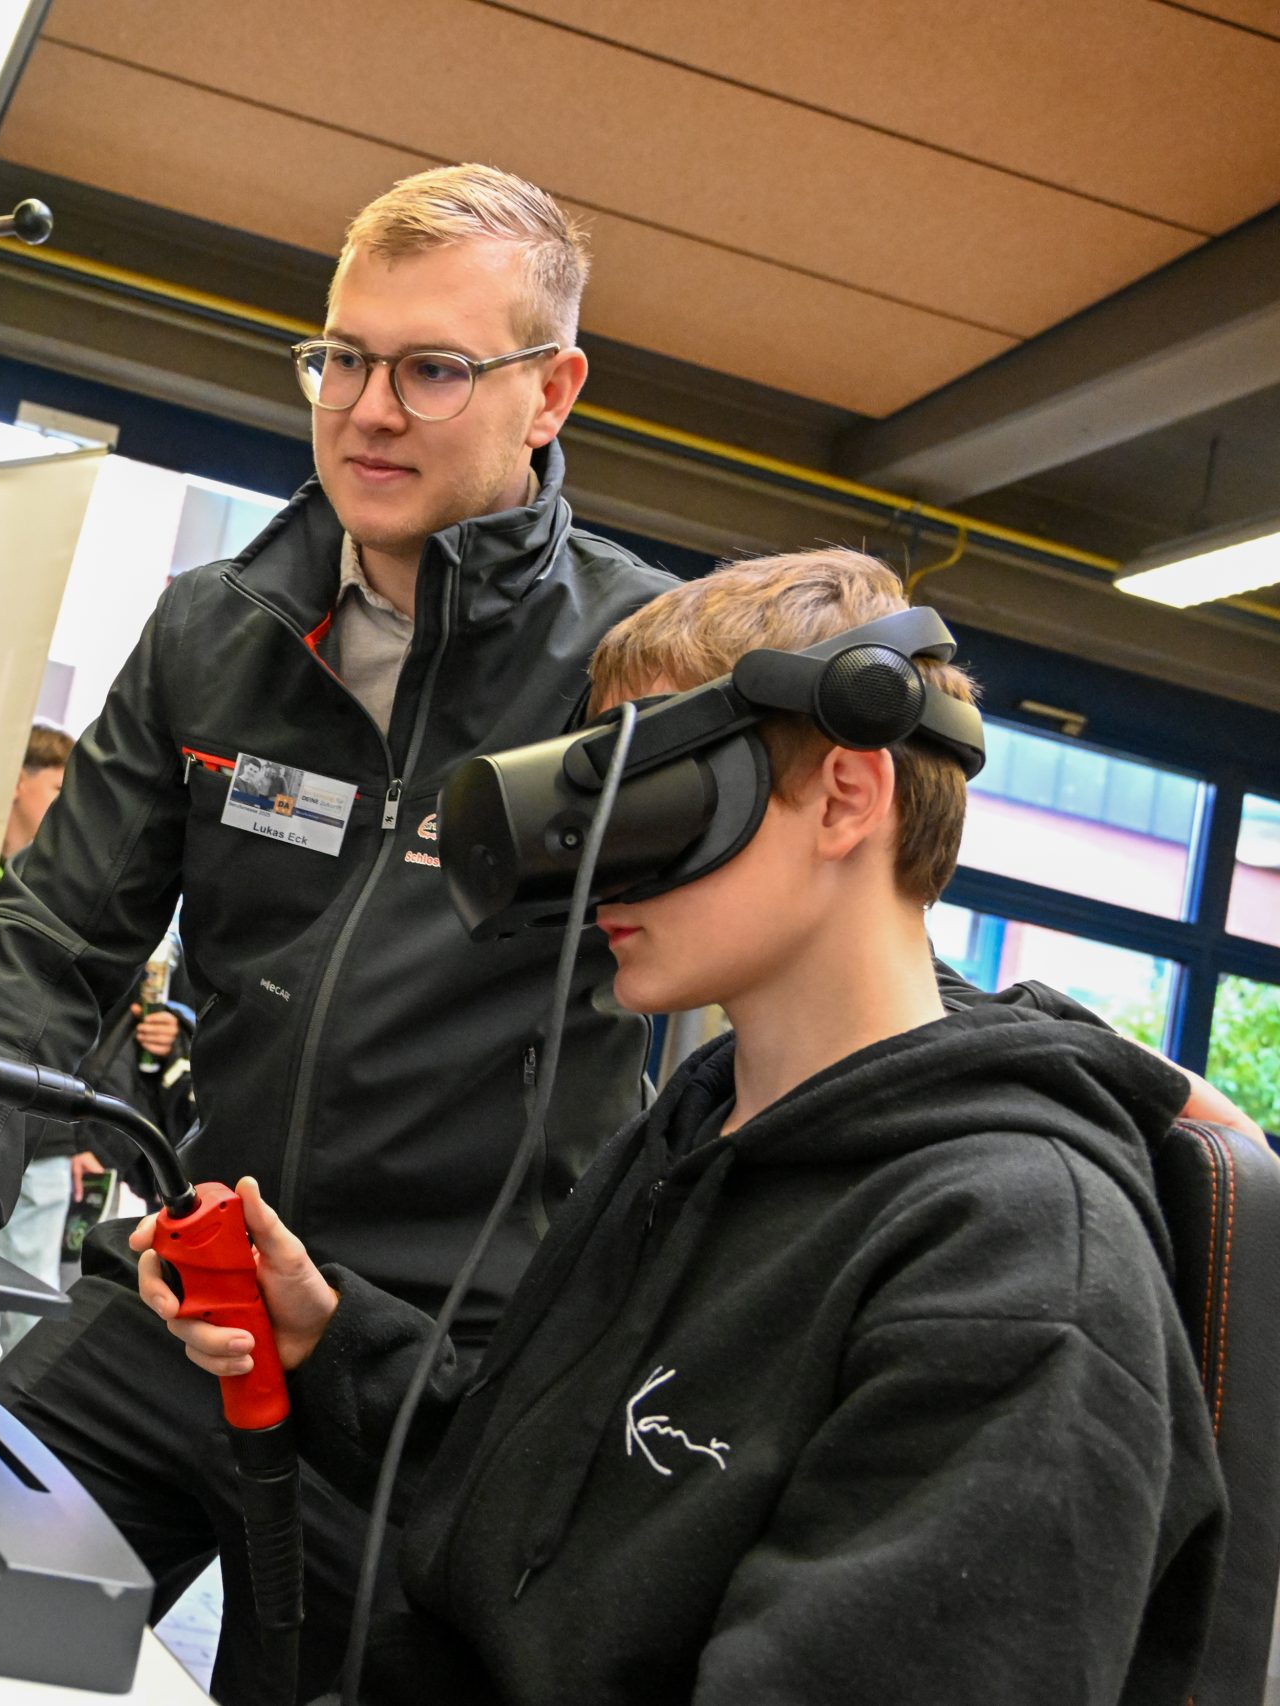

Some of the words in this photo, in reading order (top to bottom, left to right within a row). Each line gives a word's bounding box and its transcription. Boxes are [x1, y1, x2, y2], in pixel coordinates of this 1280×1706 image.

[277, 800, 290, 809] DA
[252, 821, 285, 839] Lukas
[287, 831, 308, 846] Eck
